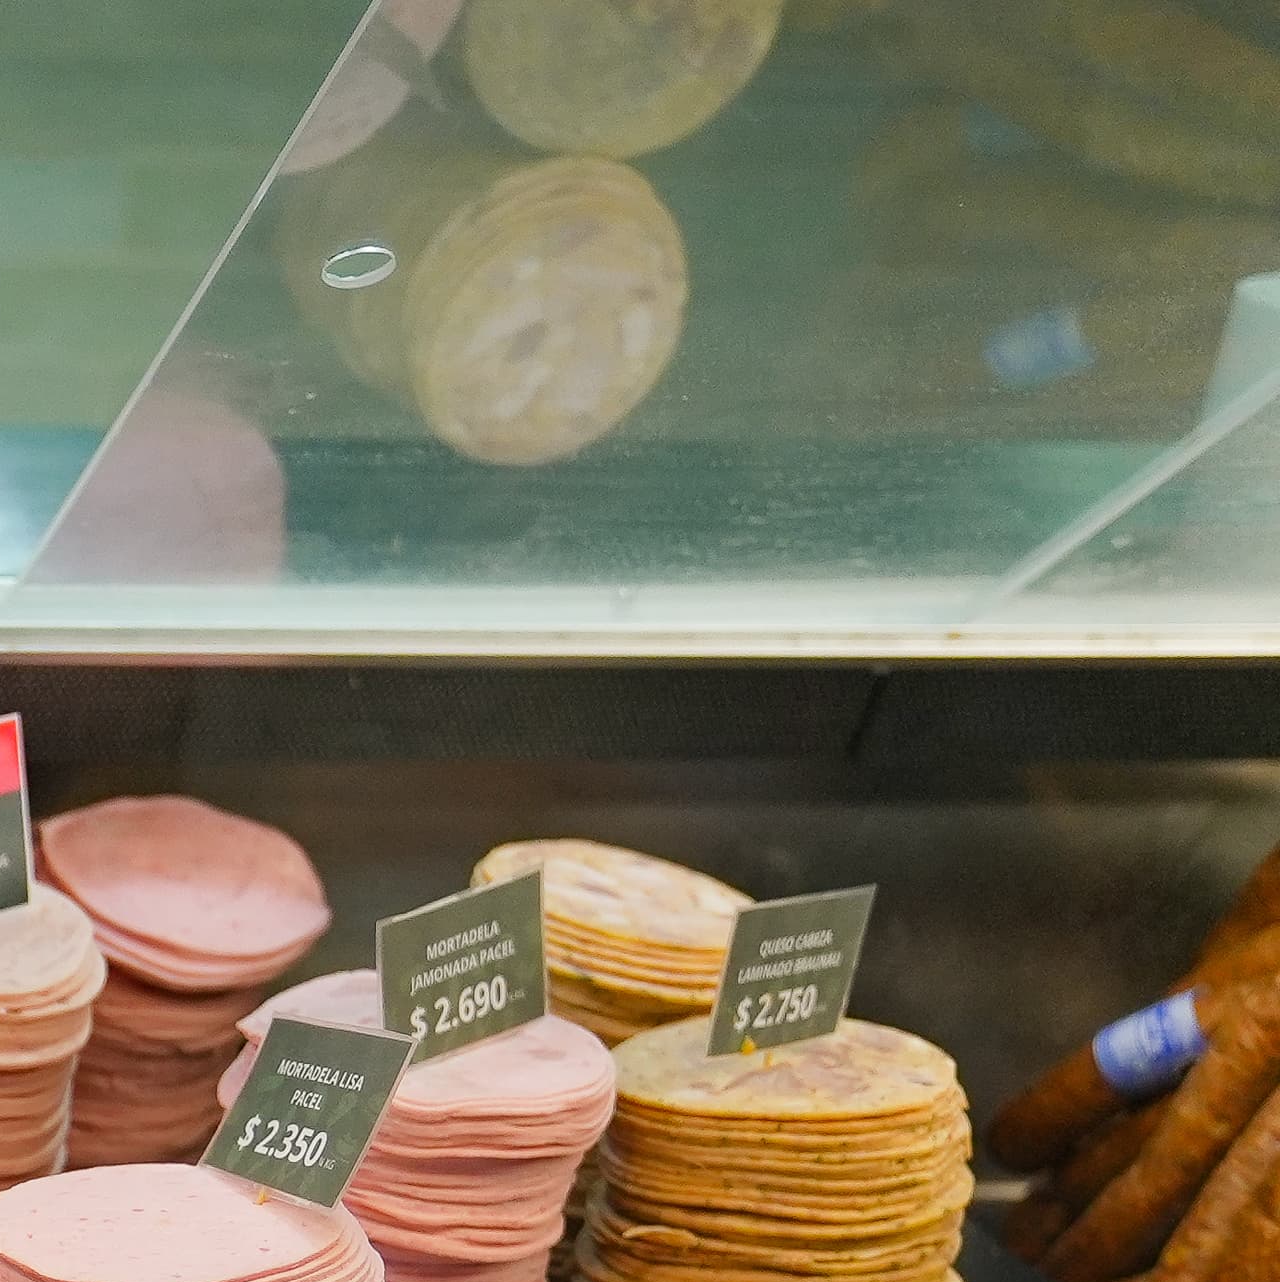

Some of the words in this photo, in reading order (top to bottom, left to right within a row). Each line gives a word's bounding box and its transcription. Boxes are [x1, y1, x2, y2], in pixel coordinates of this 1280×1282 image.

[425, 920, 501, 961] MORTADELA
[410, 953, 478, 997] JAMONADA
[410, 1004, 429, 1041] $
[433, 974, 508, 1035] 2.690
[733, 993, 753, 1034] $
[752, 984, 819, 1029] 2.750
[277, 1059, 340, 1086] MORTADELA
[338, 1071, 365, 1092] LISA
[290, 1089, 323, 1111] PACEL
[237, 1114, 261, 1151] $
[254, 1119, 328, 1167] 2.350
